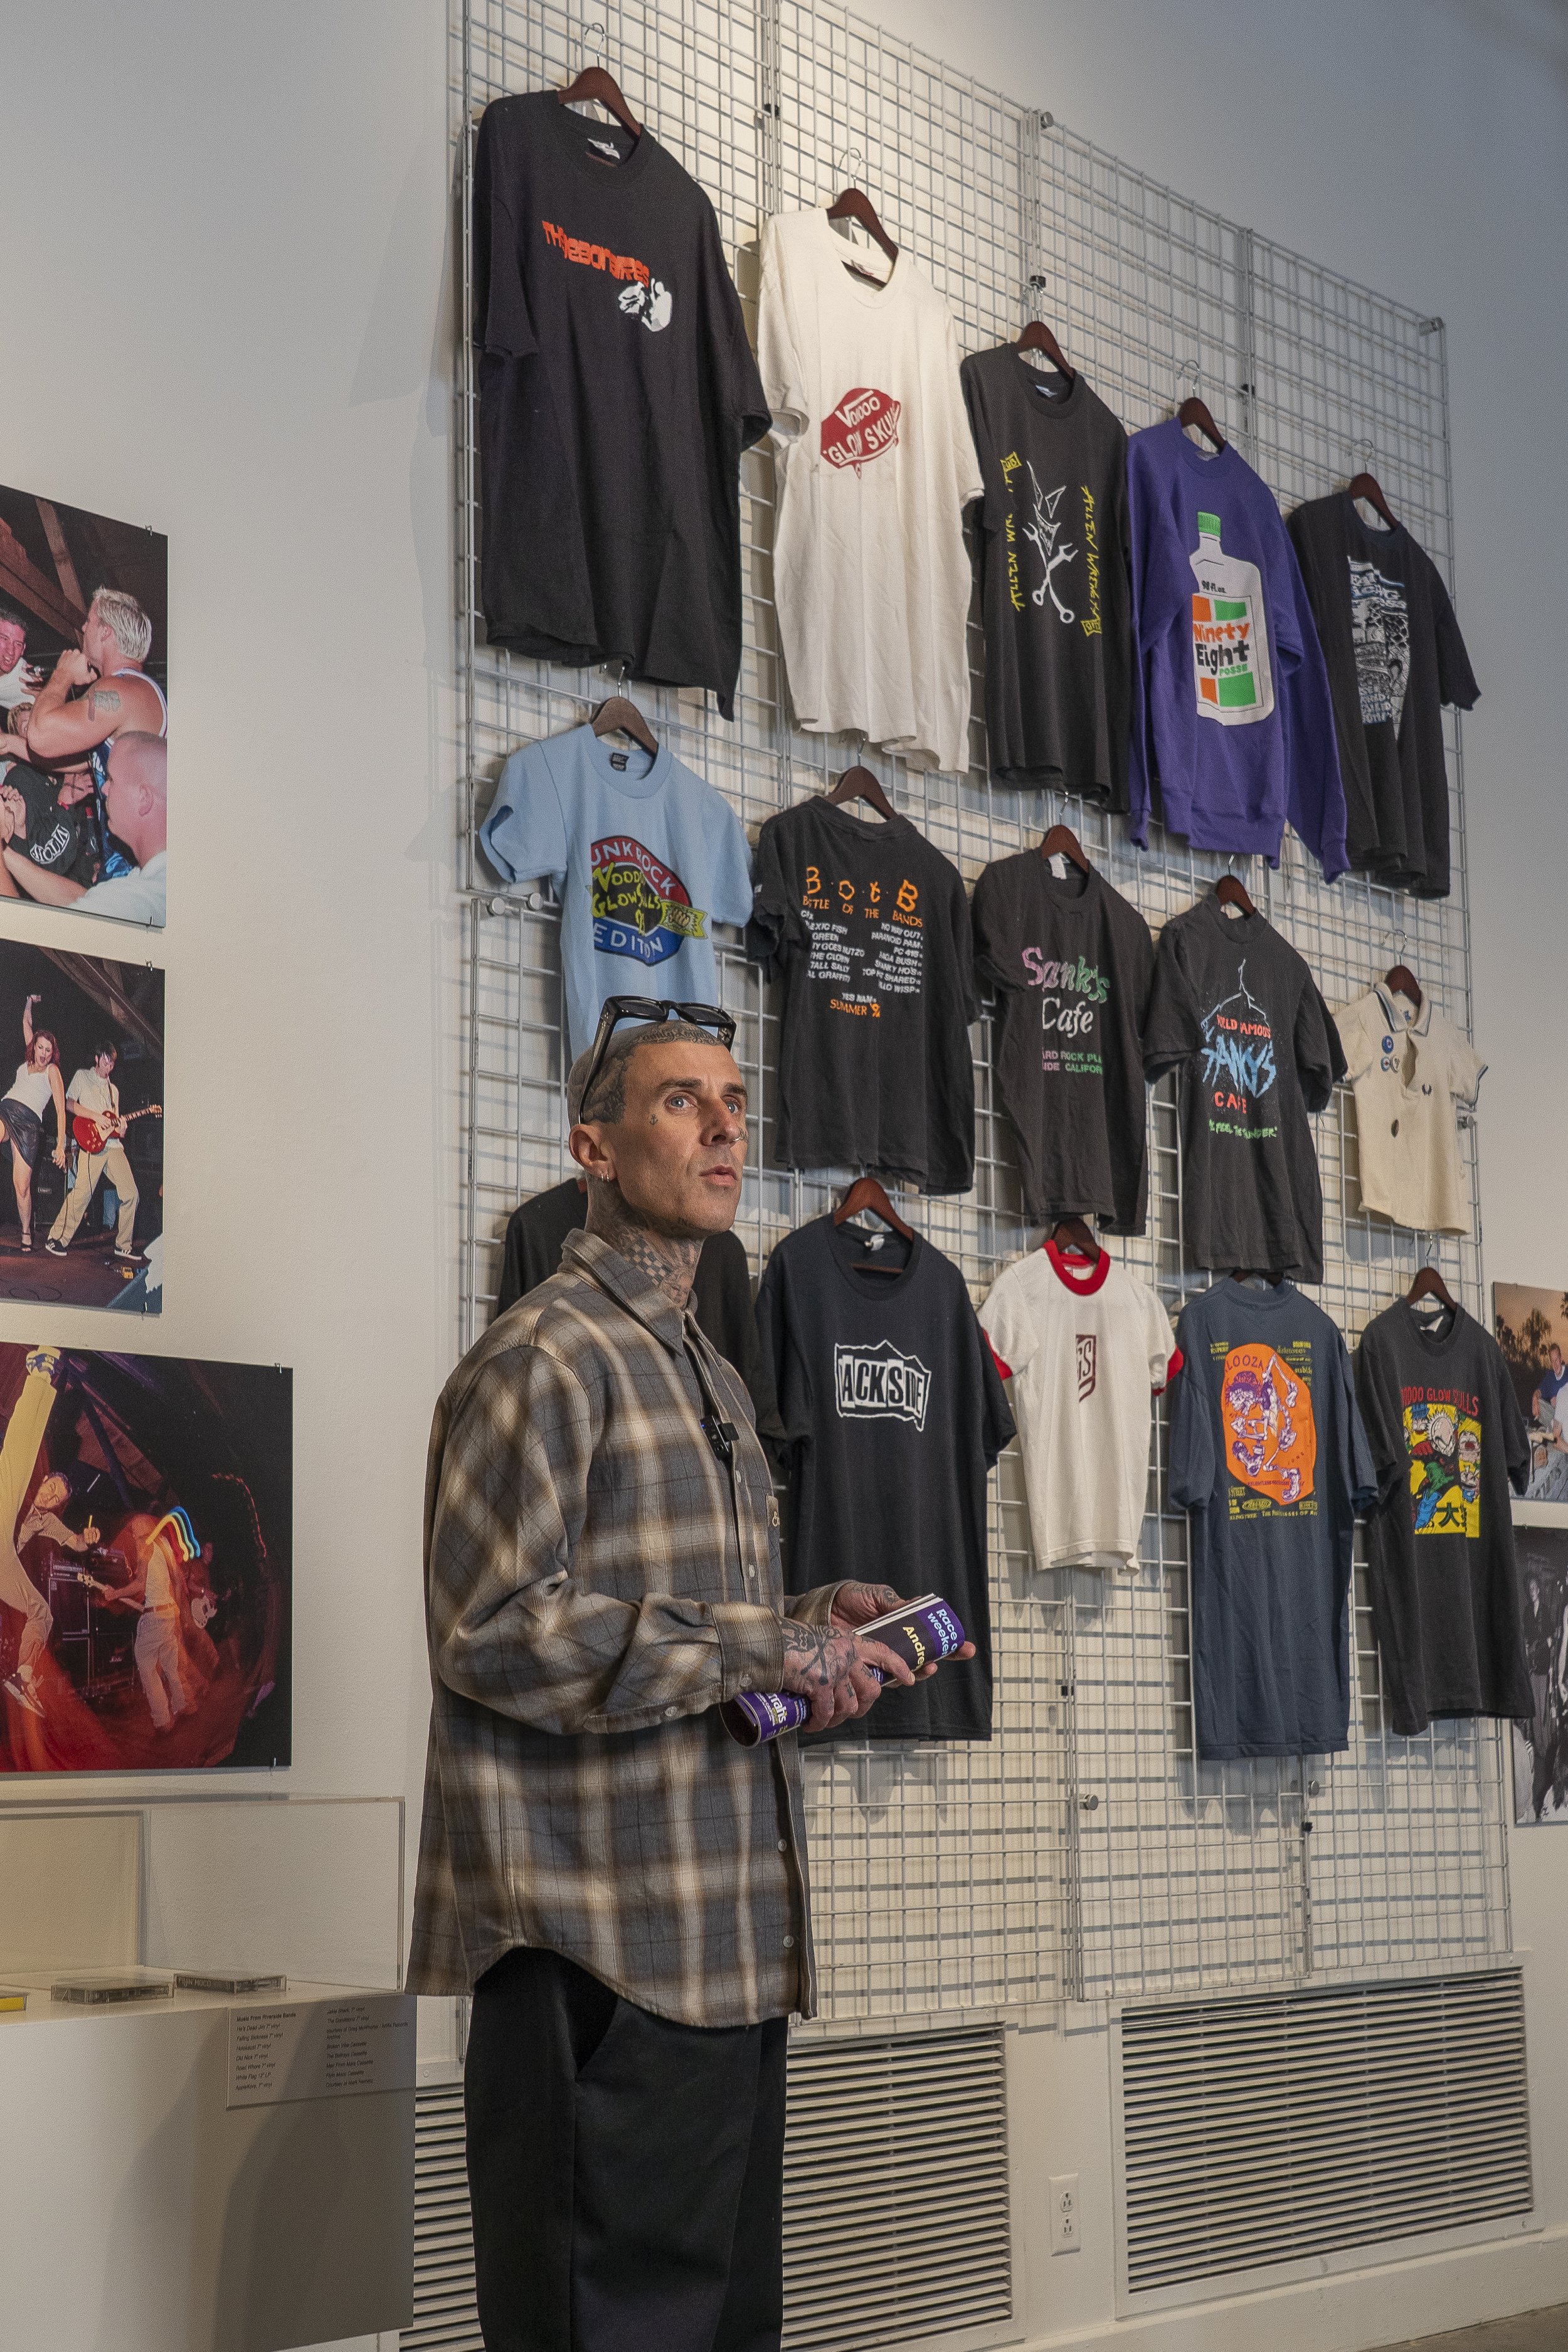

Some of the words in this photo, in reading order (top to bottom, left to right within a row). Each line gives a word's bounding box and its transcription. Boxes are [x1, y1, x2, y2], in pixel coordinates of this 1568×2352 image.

[1193, 622, 1250, 642] Ninety
[1195, 640, 1250, 675] Eight
[865, 908, 879, 919] THE
[893, 909, 923, 928] BANDS
[1042, 997, 1094, 1039] Cafe
[838, 1355, 925, 1419] ACKSIDE
[936, 1608, 958, 1641] Race
